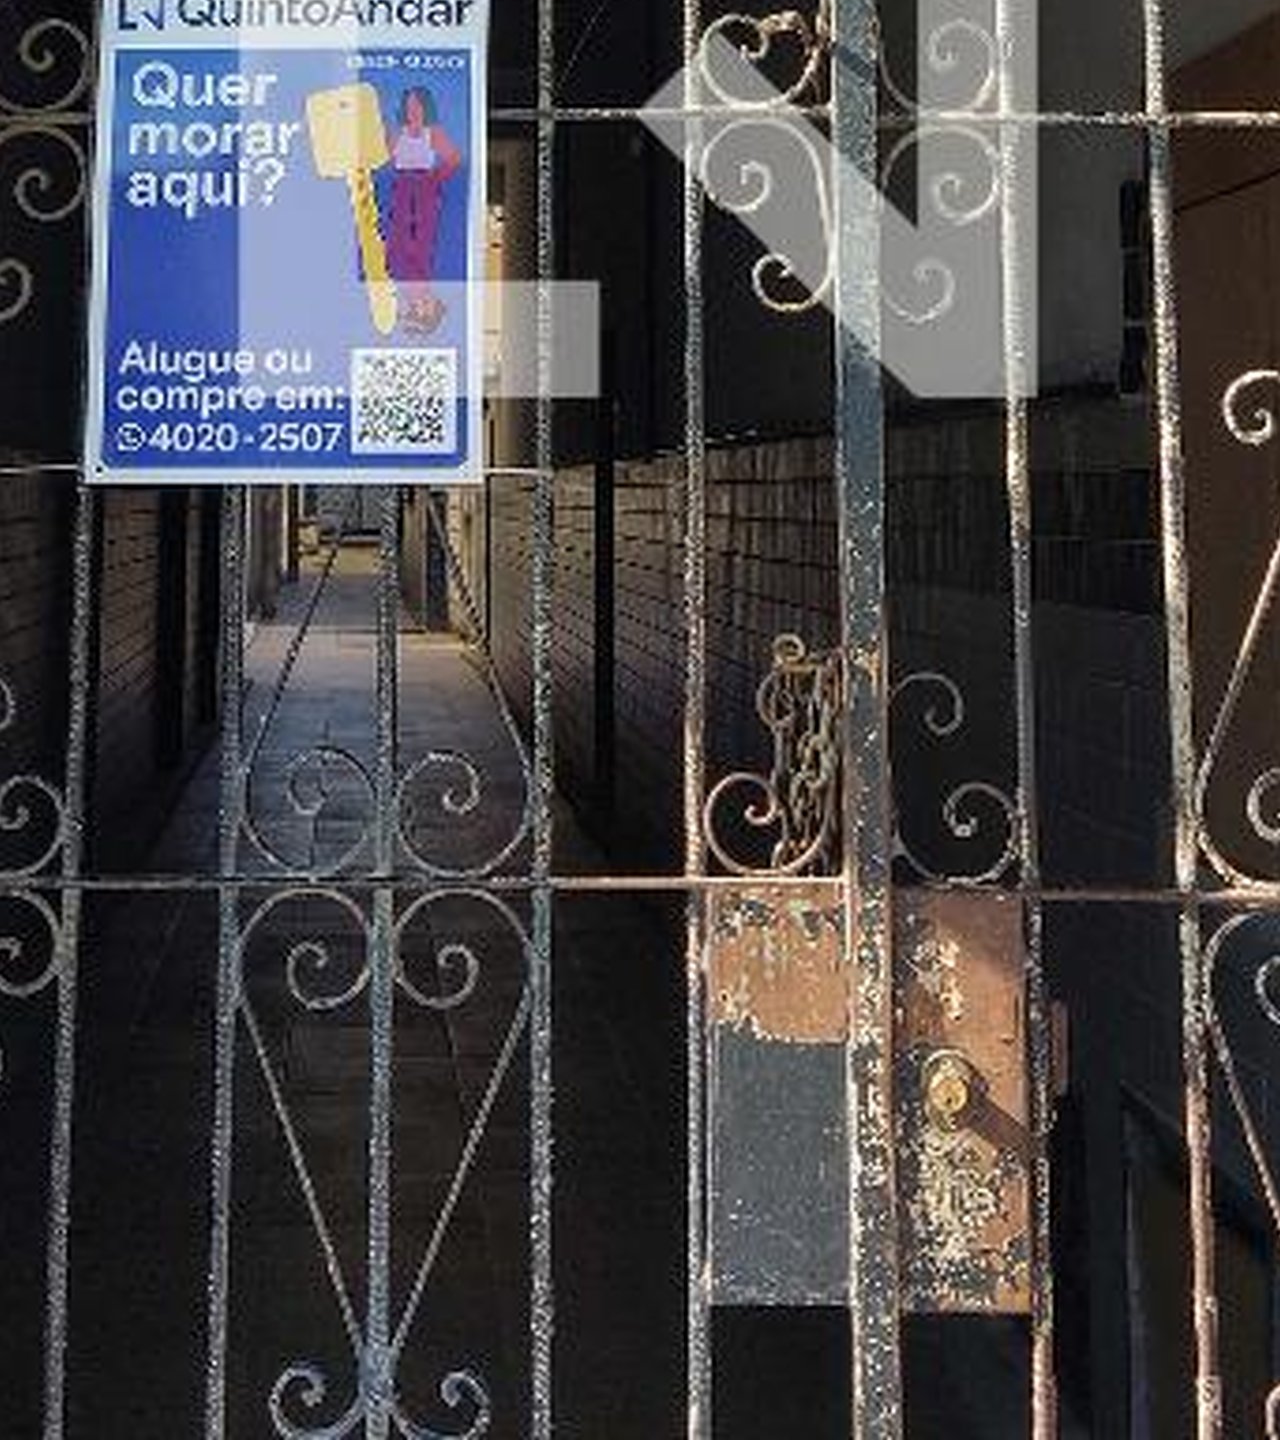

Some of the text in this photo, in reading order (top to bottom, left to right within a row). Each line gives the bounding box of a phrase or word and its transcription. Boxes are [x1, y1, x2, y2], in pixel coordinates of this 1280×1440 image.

[132, 61, 279, 110] Quer
[128, 120, 301, 157] morar
[125, 158, 287, 219] aqui?
[118, 339, 312, 383] Alugue ou
[116, 383, 347, 418] compre em:
